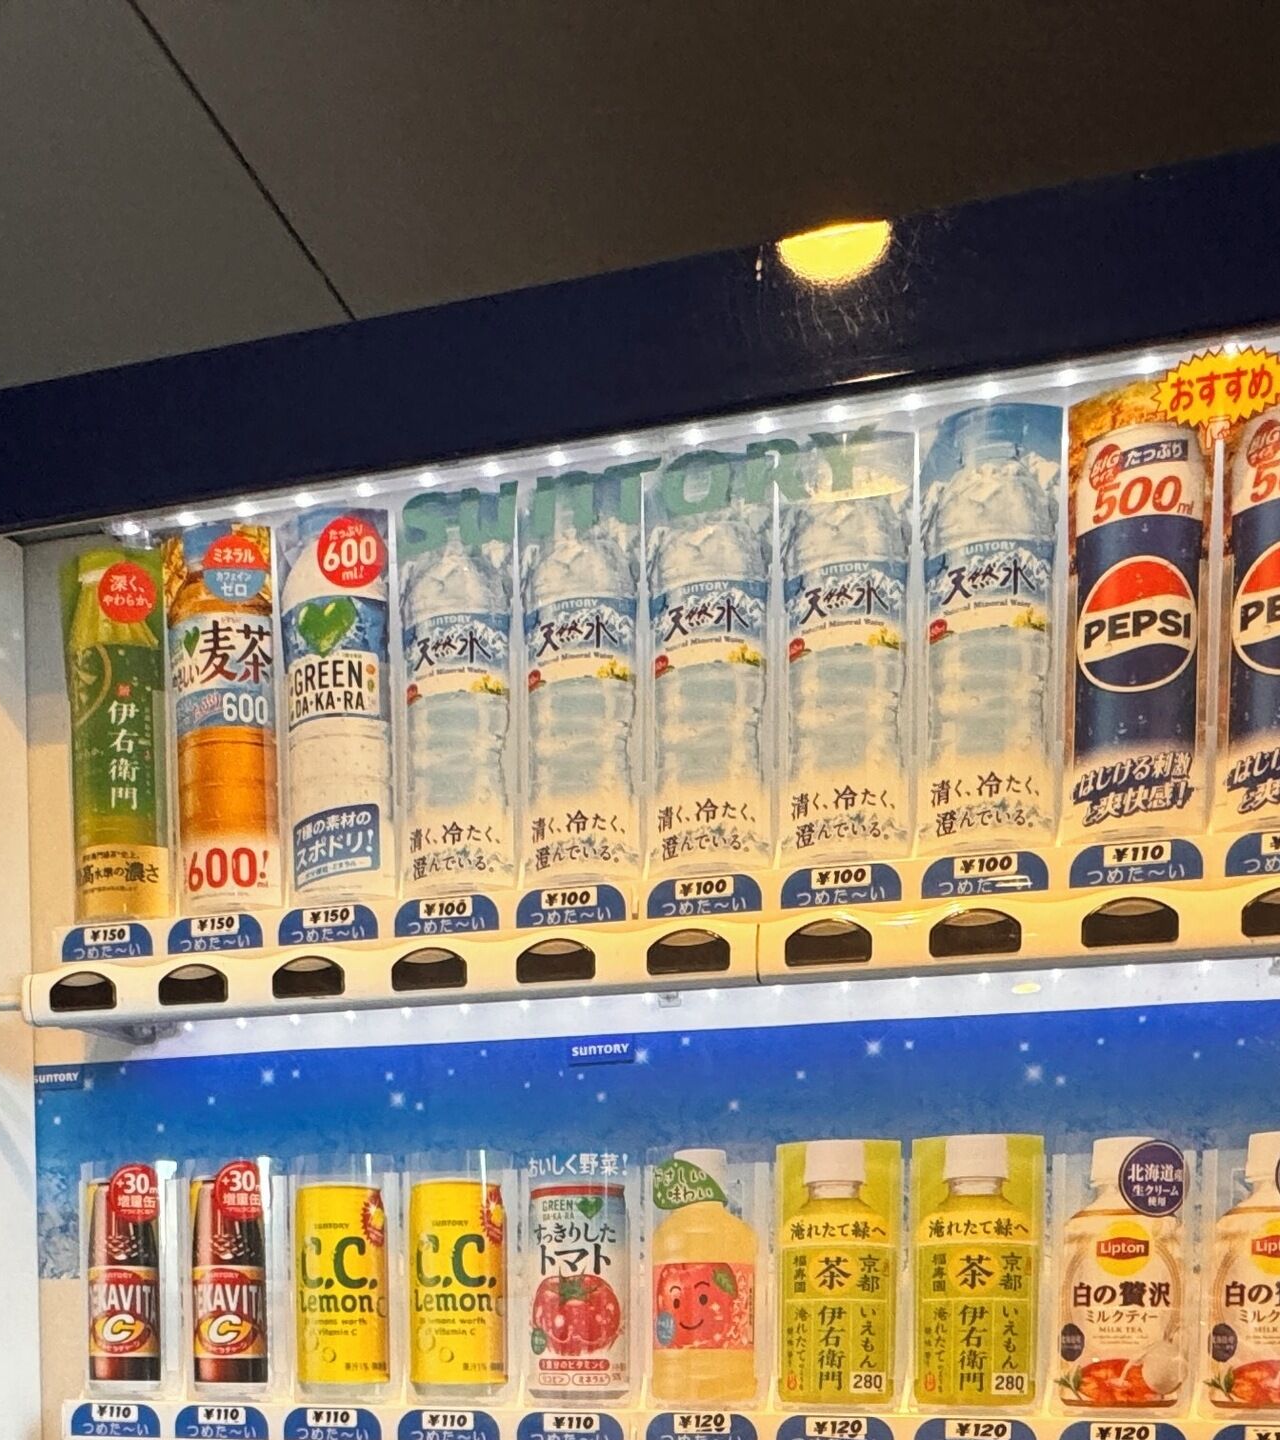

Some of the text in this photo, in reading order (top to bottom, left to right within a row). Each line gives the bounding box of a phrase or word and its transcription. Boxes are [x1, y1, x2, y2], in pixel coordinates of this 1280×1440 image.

[1169, 363, 1275, 410] おすすめ
[1124, 441, 1183, 466] たっぷり
[1092, 475, 1182, 524] 500
[329, 525, 364, 538] たっぷり
[213, 549, 255, 563] ミネラル
[323, 538, 377, 567] 600
[216, 572, 251, 583] カフェイン
[221, 584, 247, 596] ゼロ
[947, 558, 1035, 605] 天然水
[801, 580, 889, 625] 天然水
[665, 600, 748, 642] 天然水
[1084, 609, 1192, 650] PEPSI
[536, 615, 618, 657] 天然水
[199, 619, 273, 684] 麦茶
[415, 632, 491, 670] 天然水
[294, 659, 363, 695] GREEN
[222, 691, 268, 724] 600
[107, 700, 140, 811] 伊右衛門
[1077, 751, 1192, 797] はじける刺激
[960, 856, 1012, 874] ¥100
[1112, 844, 1164, 864] ¥110
[680, 879, 727, 896] ¥100
[817, 867, 866, 886] ¥100
[423, 900, 467, 916] ¥100
[546, 890, 590, 906] ¥100
[310, 908, 349, 922] ¥150
[91, 928, 125, 941] ¥150
[572, 1043, 630, 1057] SUNTORY
[667, 1185, 714, 1201] 味わい
[534, 1223, 616, 1244] すっきりした
[540, 1244, 611, 1275] トマト
[1100, 1242, 1145, 1256] Lipton
[816, 1256, 851, 1290] 茶
[858, 1254, 880, 1293] 京都
[956, 1255, 994, 1289] 茶
[999, 1252, 1022, 1291] 京都
[1073, 1281, 1170, 1307] 白の贅沢
[103, 1314, 135, 1343] C
[1085, 1310, 1159, 1324] ミルクティー
[818, 1306, 847, 1390] 伊右衛門
[860, 1306, 877, 1369] いえもん
[959, 1305, 988, 1392] 伊右衛門
[1002, 1306, 1018, 1370] いえもん
[853, 1375, 882, 1390] 280
[995, 1376, 1024, 1391] 280
[97, 1404, 133, 1419] ¥110
[312, 1409, 350, 1424] ¥110
[427, 1413, 468, 1428] ¥110
[553, 1416, 594, 1430] ¥110
[679, 1414, 725, 1430] ¥120
[814, 1420, 863, 1436] ¥120
